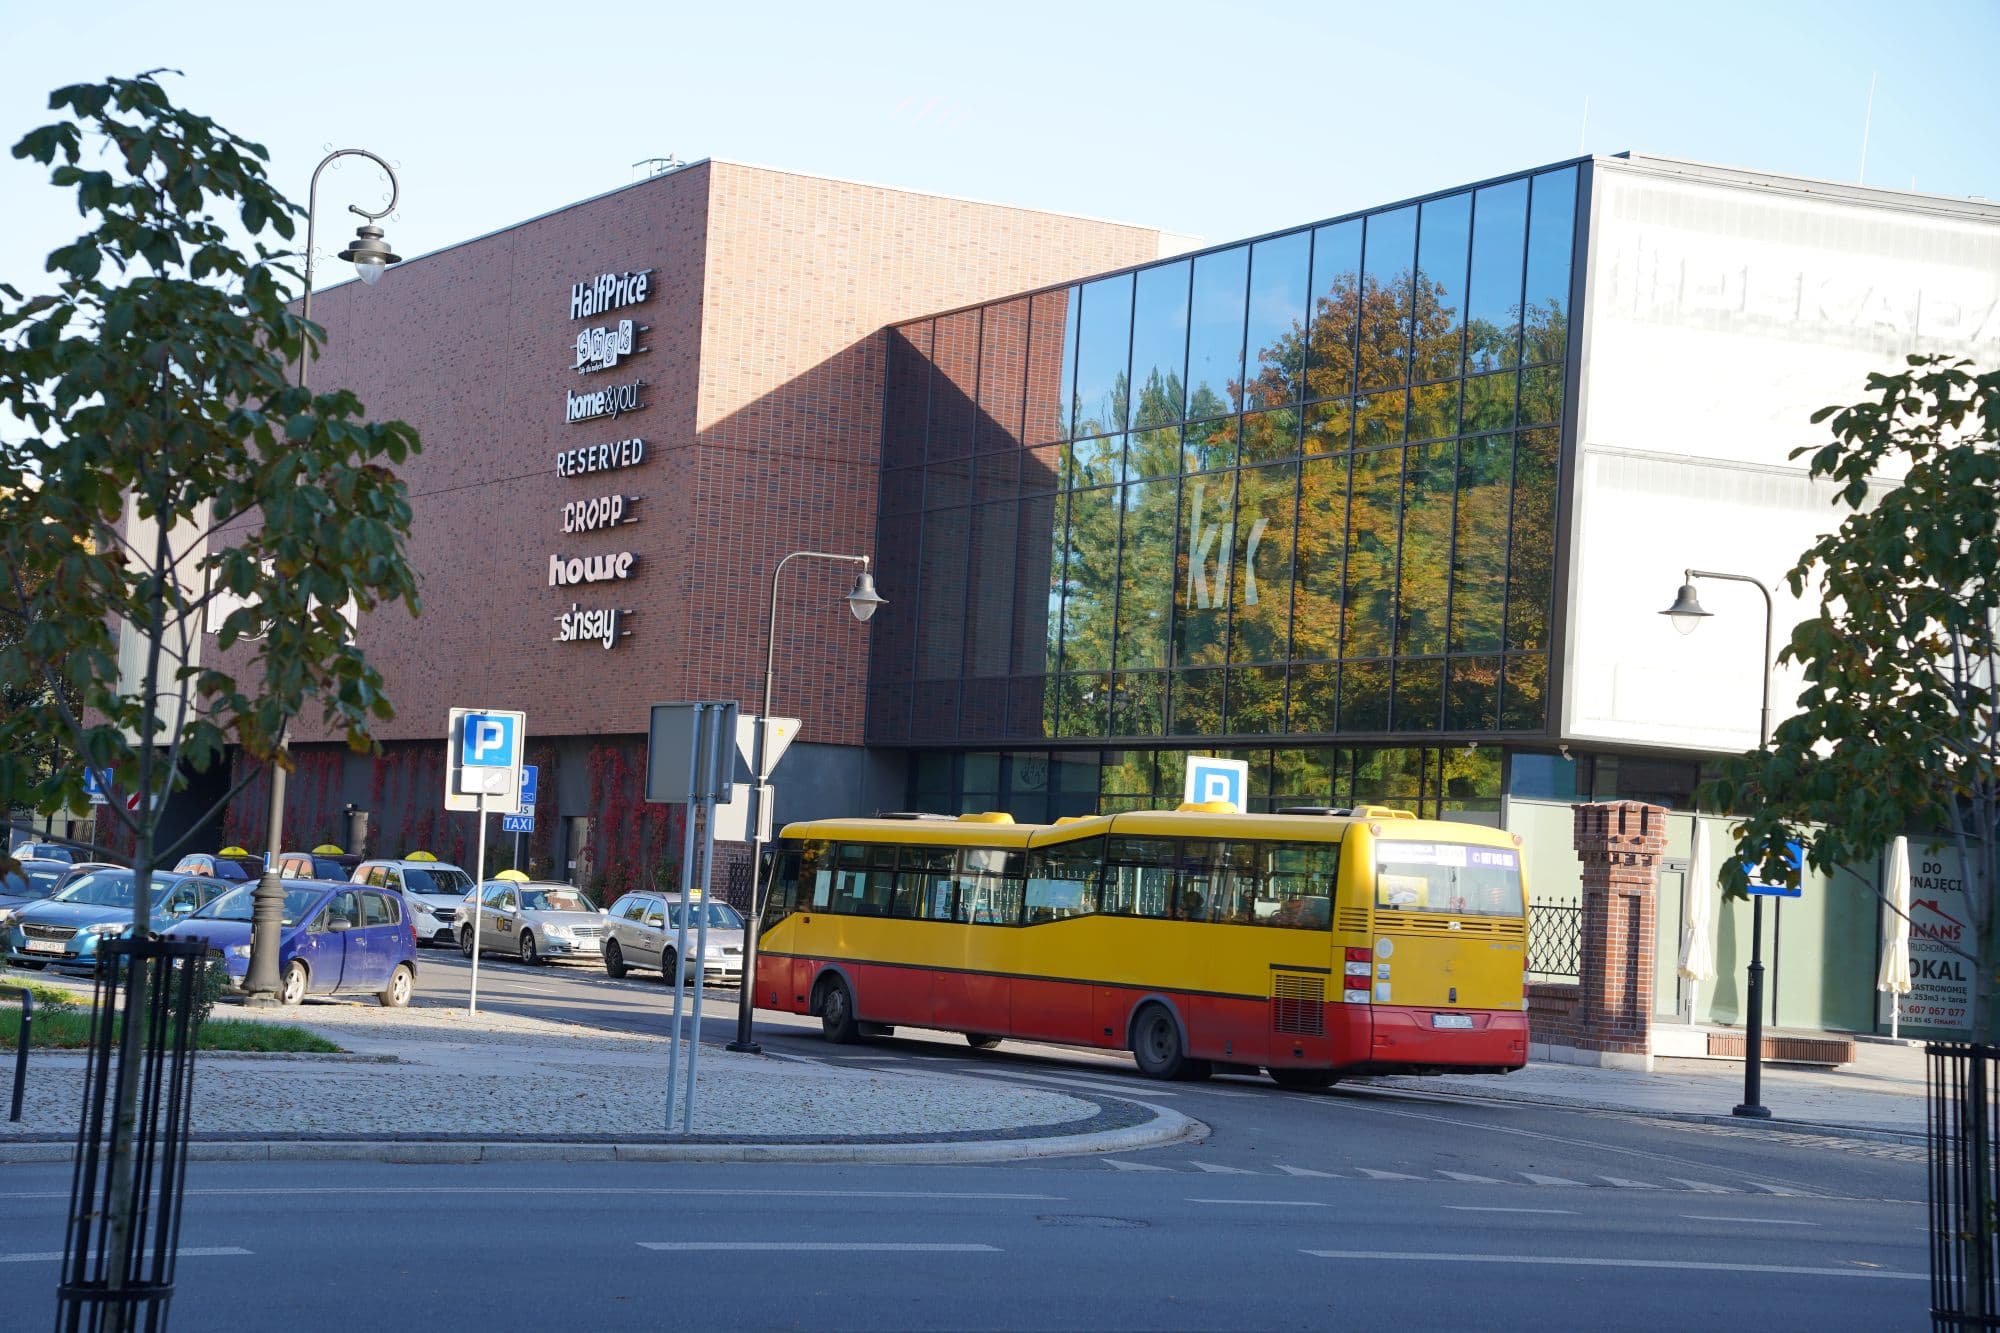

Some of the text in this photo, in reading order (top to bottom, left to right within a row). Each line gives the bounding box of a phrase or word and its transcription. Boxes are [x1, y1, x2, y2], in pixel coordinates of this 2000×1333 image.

[571, 271, 647, 320] HalfPrice
[566, 384, 639, 421] home&you
[557, 438, 643, 477] RESERVED
[564, 494, 623, 533] CROPP
[549, 551, 634, 586] house
[560, 603, 615, 650] sinsay
[474, 721, 504, 760] P
[504, 817, 532, 831] TAXI
[1910, 876, 1963, 893] NAJĘCI
[1923, 862, 1942, 875] DO
[1909, 923, 1962, 940] INANS
[1909, 958, 1968, 982] OKAL
[1909, 1005, 1926, 1014] 607
[1928, 1006, 1945, 1016] 067
[1948, 1008, 1966, 1017] 077
